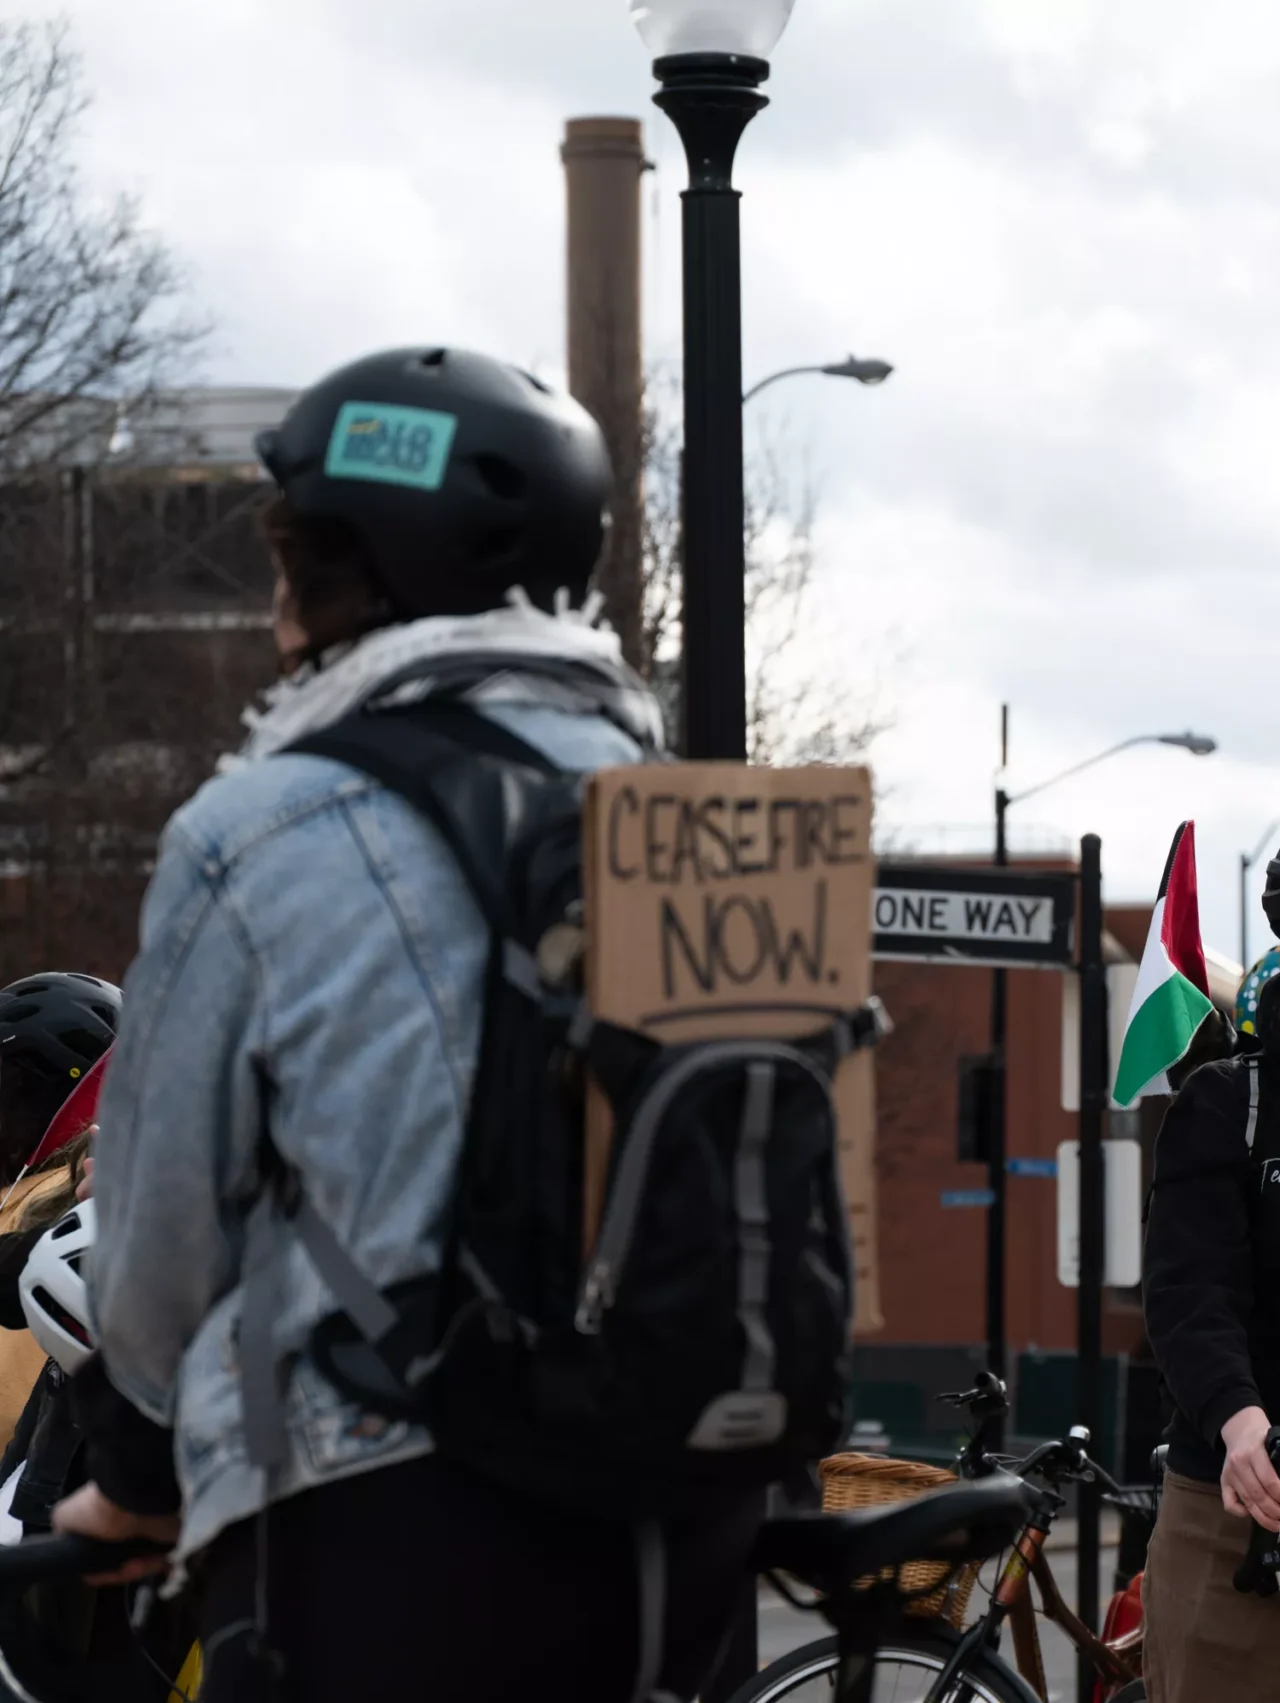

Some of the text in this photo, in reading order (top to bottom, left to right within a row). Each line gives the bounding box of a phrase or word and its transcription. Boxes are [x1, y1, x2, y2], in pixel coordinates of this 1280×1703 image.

[608, 786, 867, 886] CEASEFIRE
[659, 878, 840, 999] NOW.
[875, 895, 1042, 936] ONE WAY
